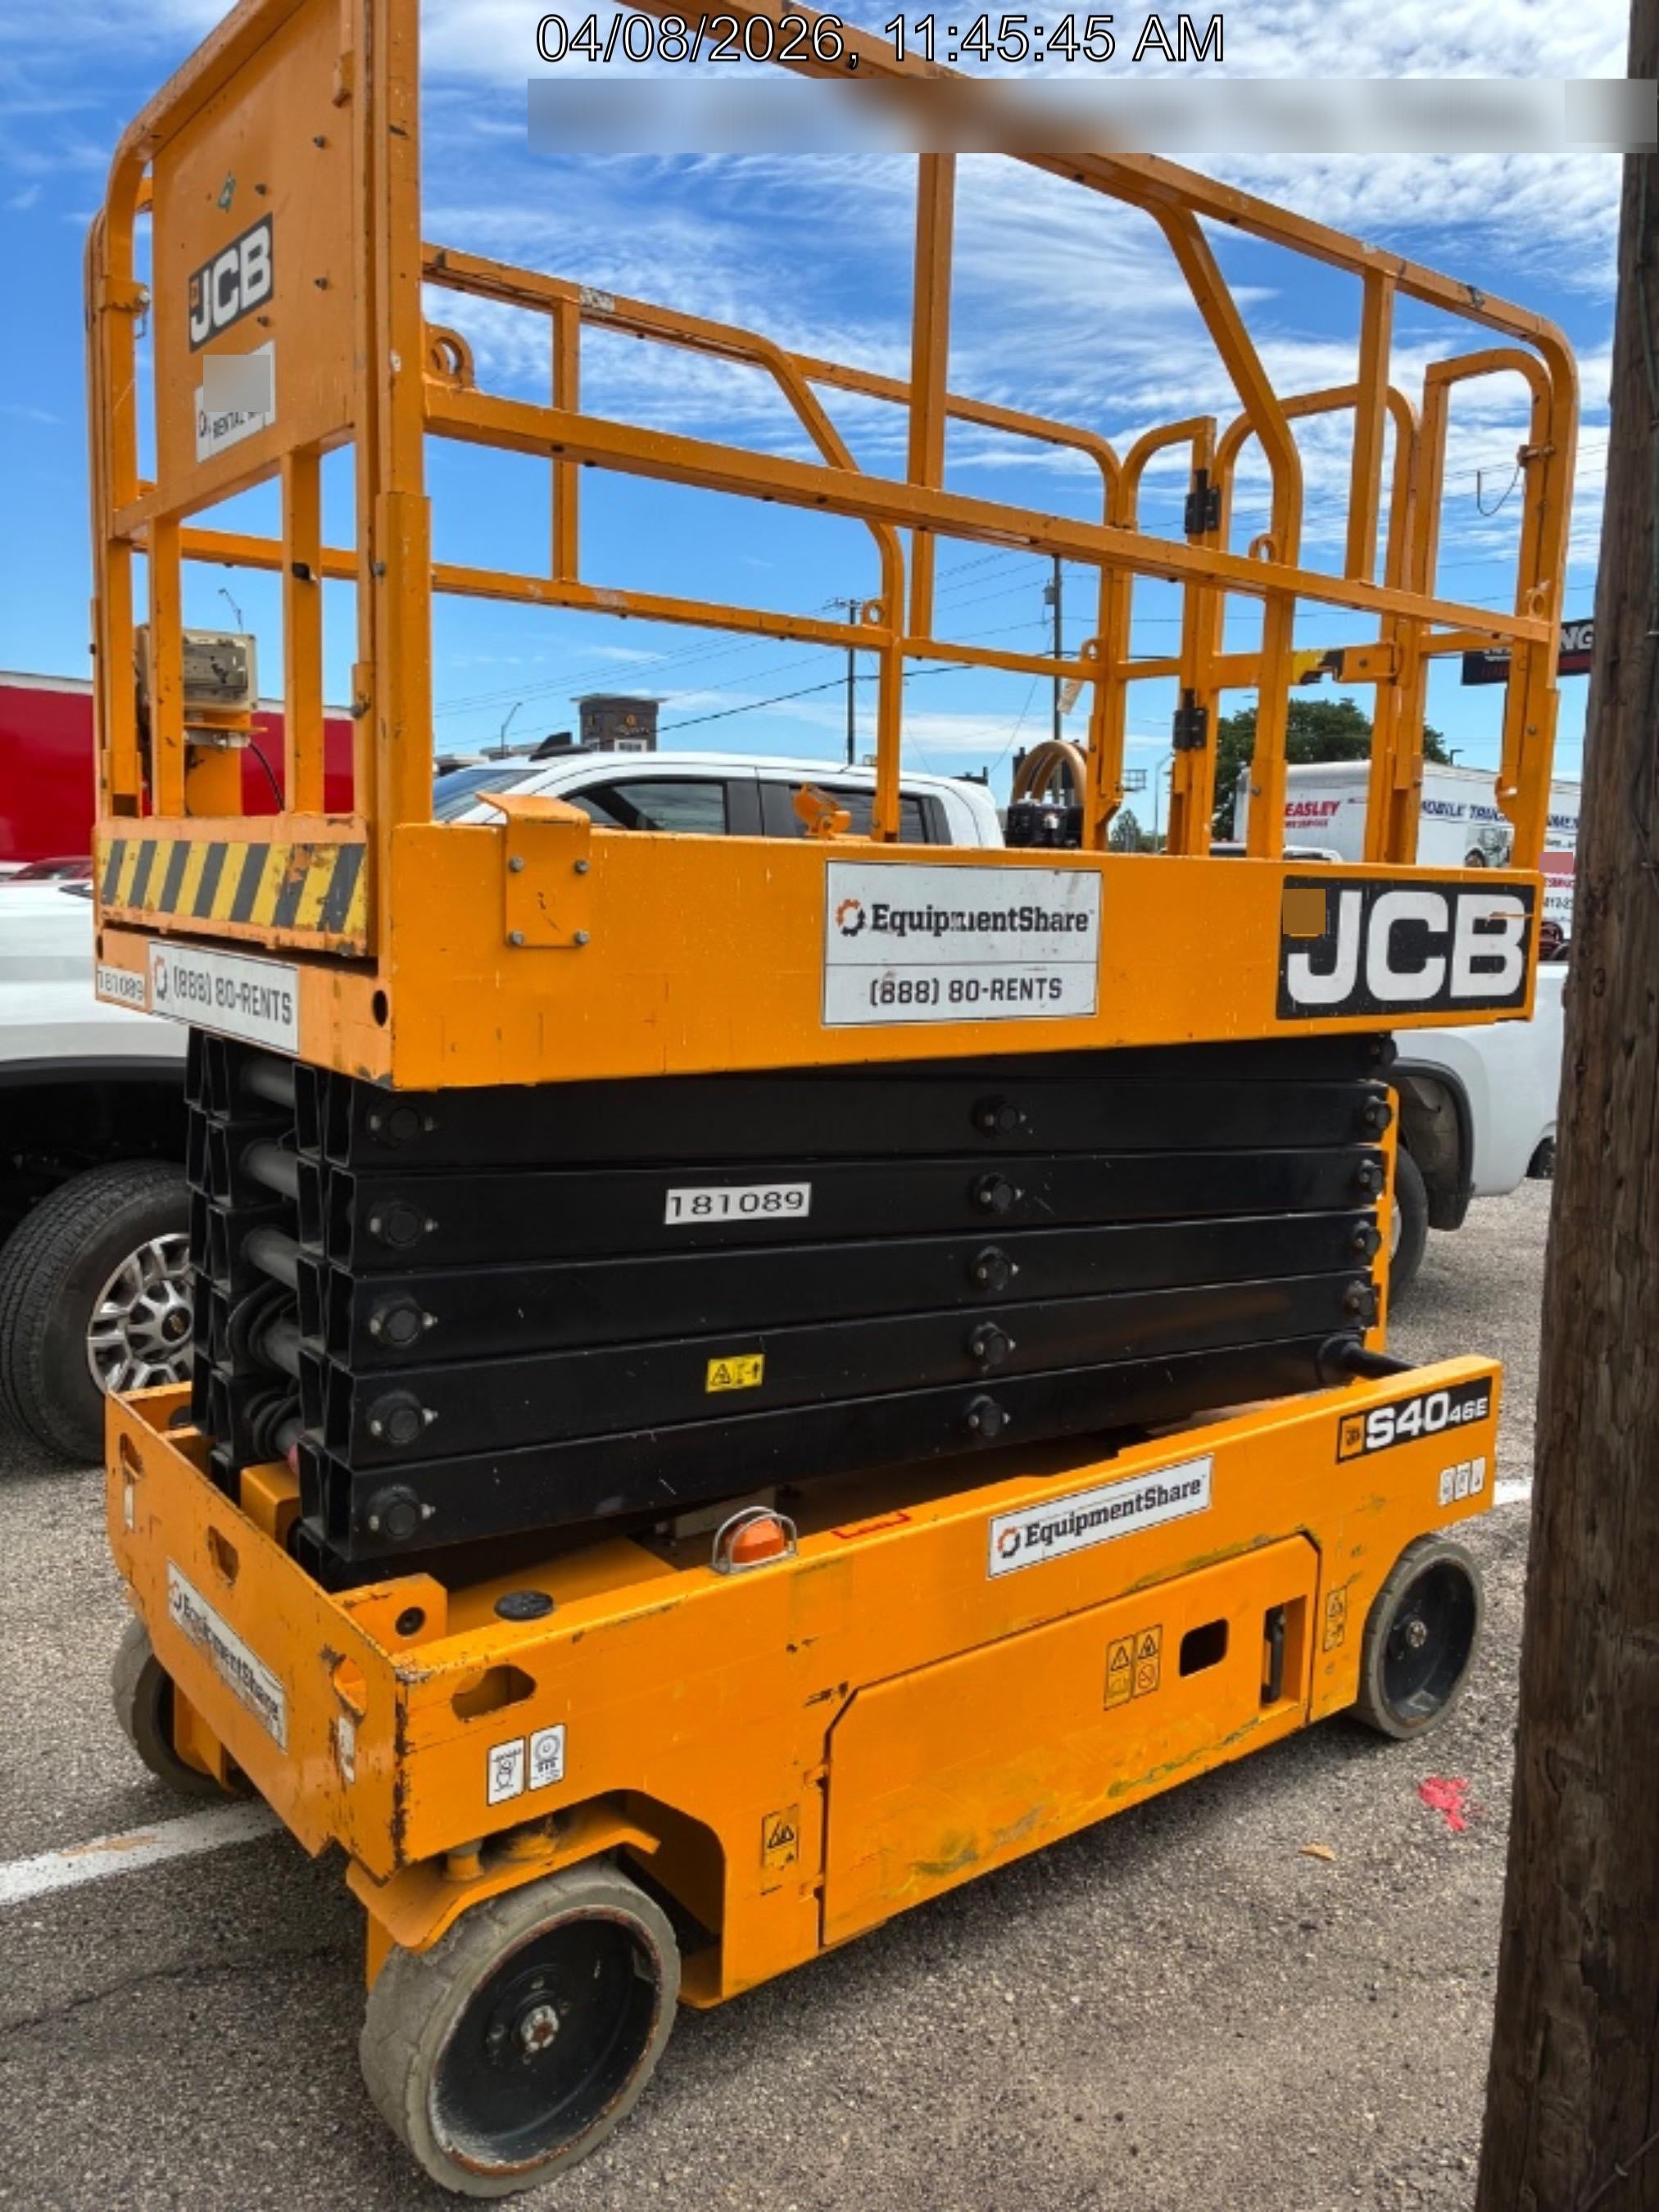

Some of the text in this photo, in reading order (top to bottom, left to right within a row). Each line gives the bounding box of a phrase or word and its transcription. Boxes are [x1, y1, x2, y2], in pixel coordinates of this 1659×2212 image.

[190, 224, 272, 343] JCB
[871, 903, 1089, 937] EquipmentShare
[1286, 889, 1525, 1004] JCB
[173, 966, 293, 1026] (888) 80-RENTS
[869, 977, 1063, 1008] (888) 80-RENTS
[670, 1190, 805, 1218] 181089
[1024, 1478, 1202, 1547] EquipmentShare
